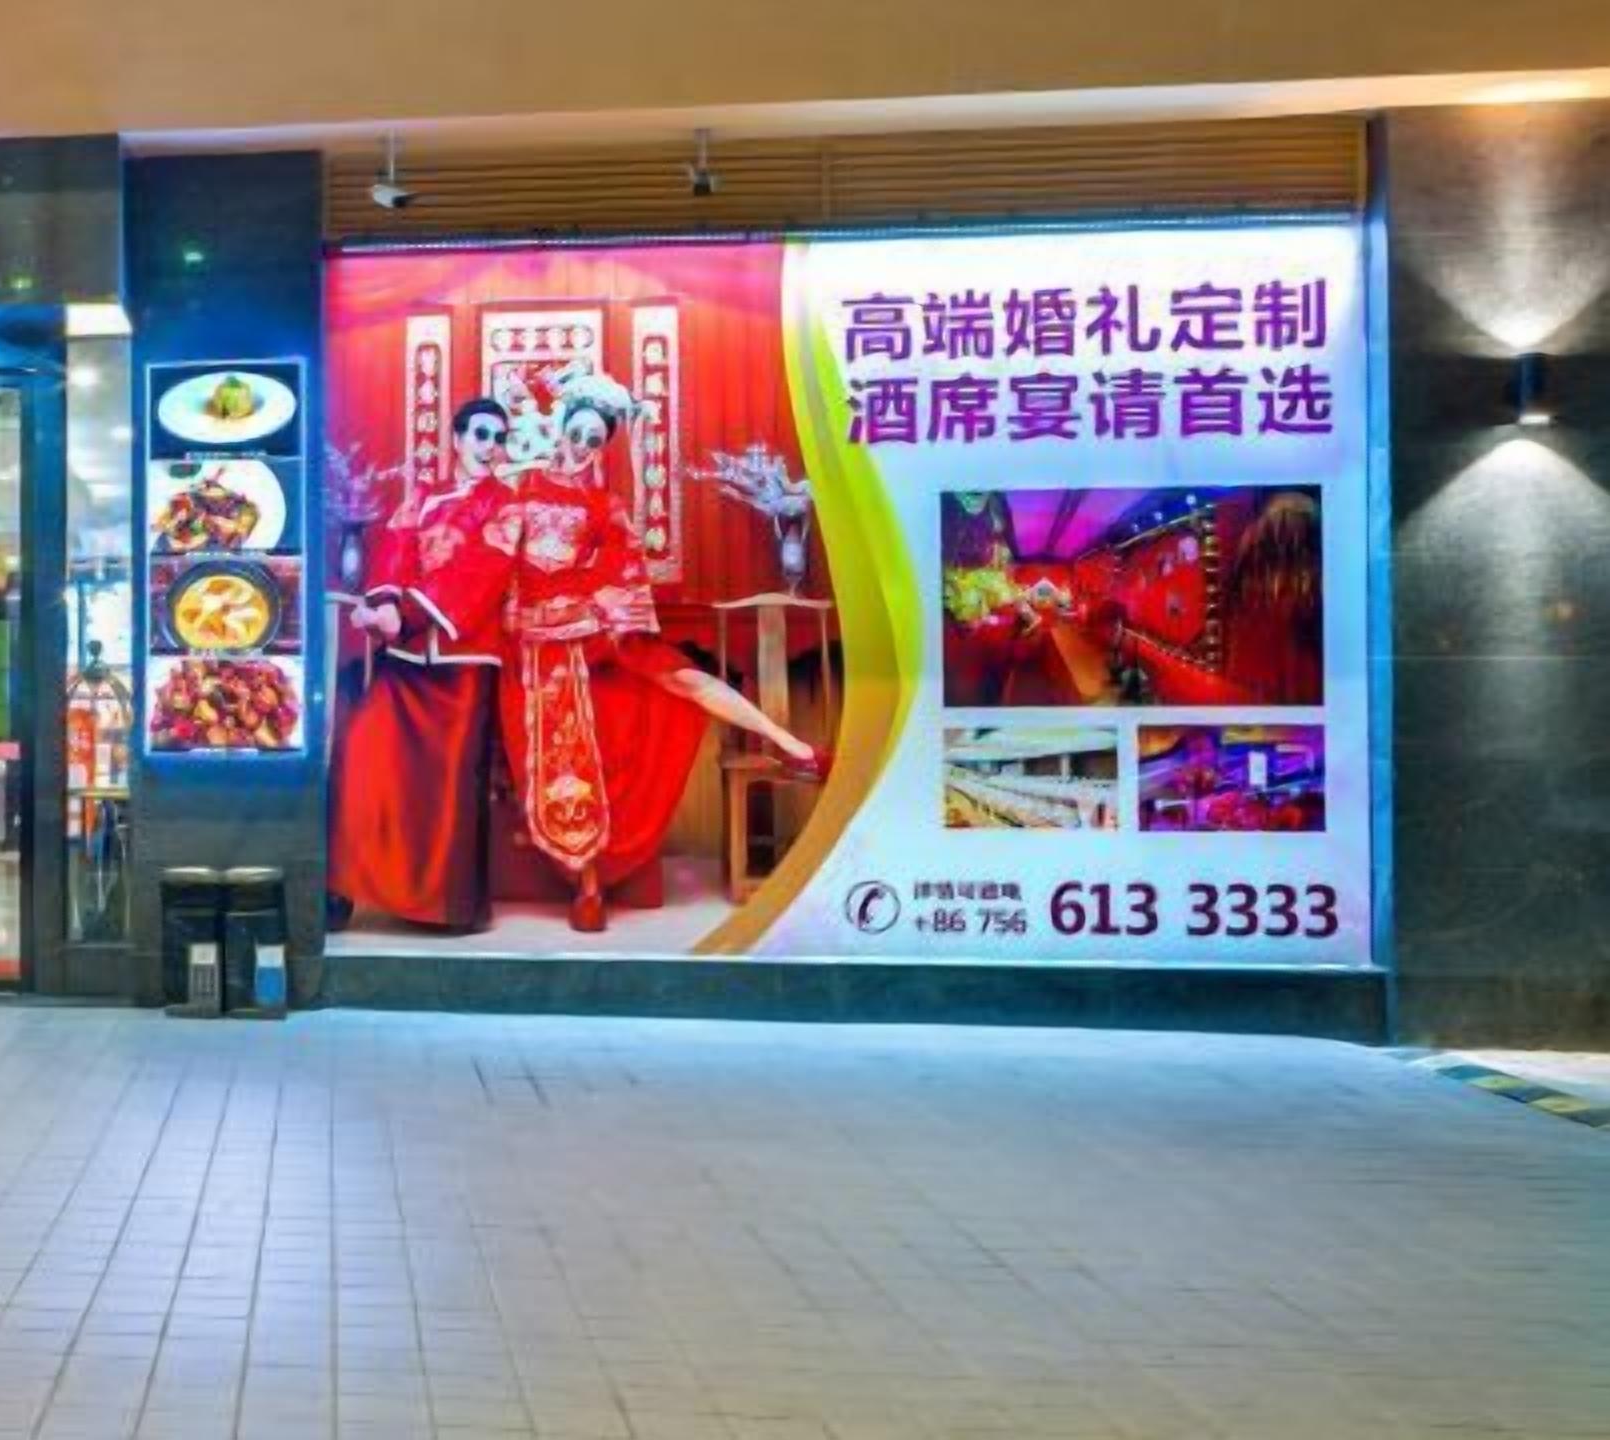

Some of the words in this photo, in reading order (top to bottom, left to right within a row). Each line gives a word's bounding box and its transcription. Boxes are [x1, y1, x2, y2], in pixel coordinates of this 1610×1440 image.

[841, 277, 1328, 361] 高端婚礼定制
[846, 363, 1334, 445] 酒席宴请首选
[915, 909, 966, 933] +86
[976, 908, 1027, 935] 756
[1049, 880, 1160, 936] 613
[1186, 882, 1339, 939] 3333
